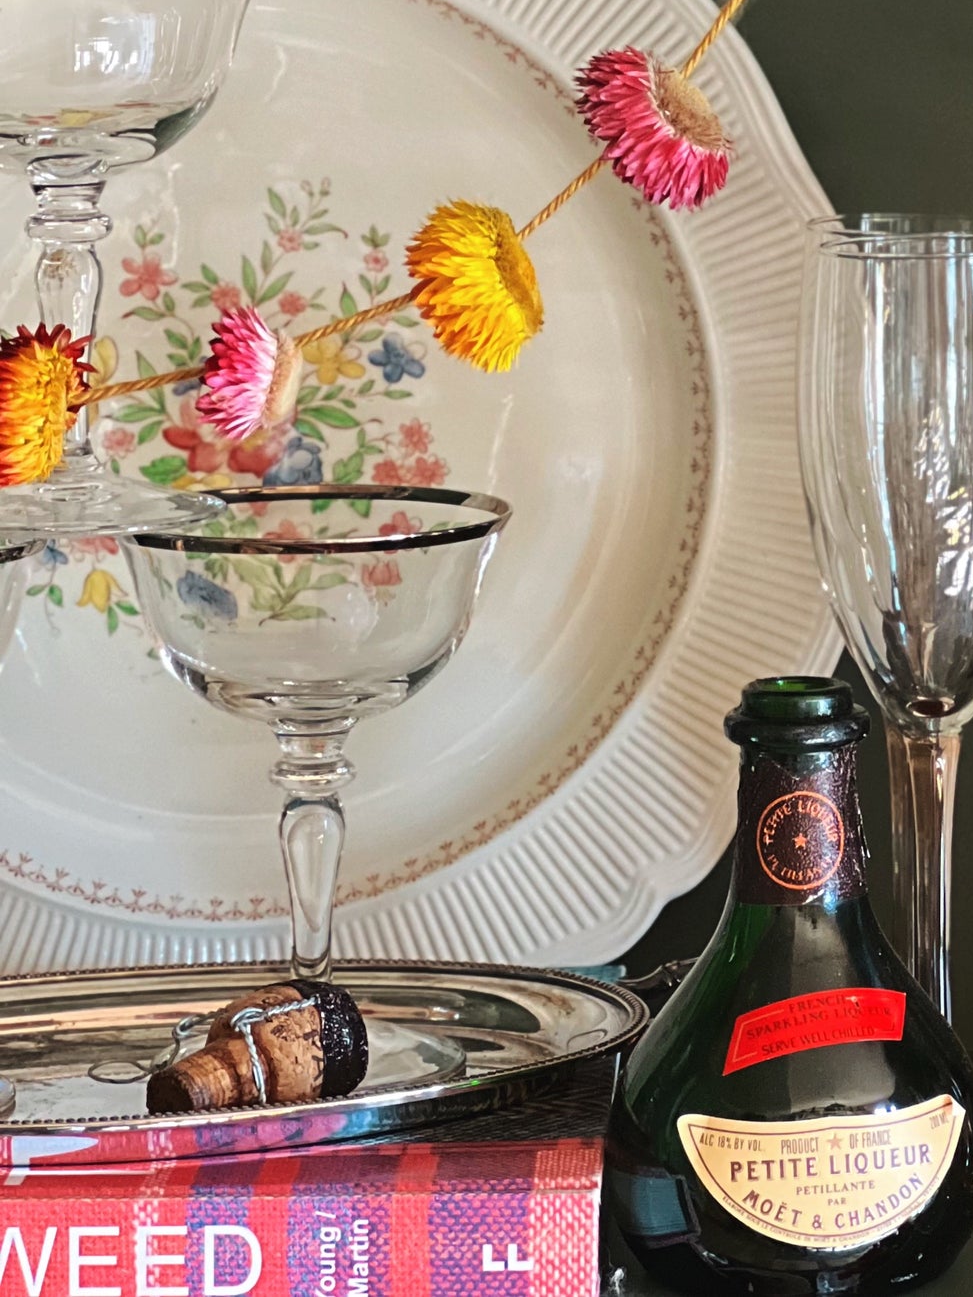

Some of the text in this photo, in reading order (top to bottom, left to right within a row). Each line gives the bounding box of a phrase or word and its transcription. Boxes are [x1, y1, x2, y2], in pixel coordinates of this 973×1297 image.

[789, 995, 847, 1014] FRENCH
[746, 1010, 828, 1040] SPARKLING
[761, 1027, 875, 1055] SERVE WELL CHILLED
[699, 1132, 713, 1147] ALC
[717, 1136, 732, 1149] 18%
[734, 1138, 745, 1150] BY
[781, 1129, 891, 1154] PRODUCT OF FRANCE
[730, 1144, 931, 1182] PETITE LIQUEUR
[796, 1180, 876, 1195] PETILLANTE
[742, 1189, 803, 1227] MOËT
[812, 1214, 824, 1230] &
[834, 1173, 924, 1229] CHANDON
[827, 1198, 847, 1206] PAR
[347, 1219, 369, 1297] Martin
